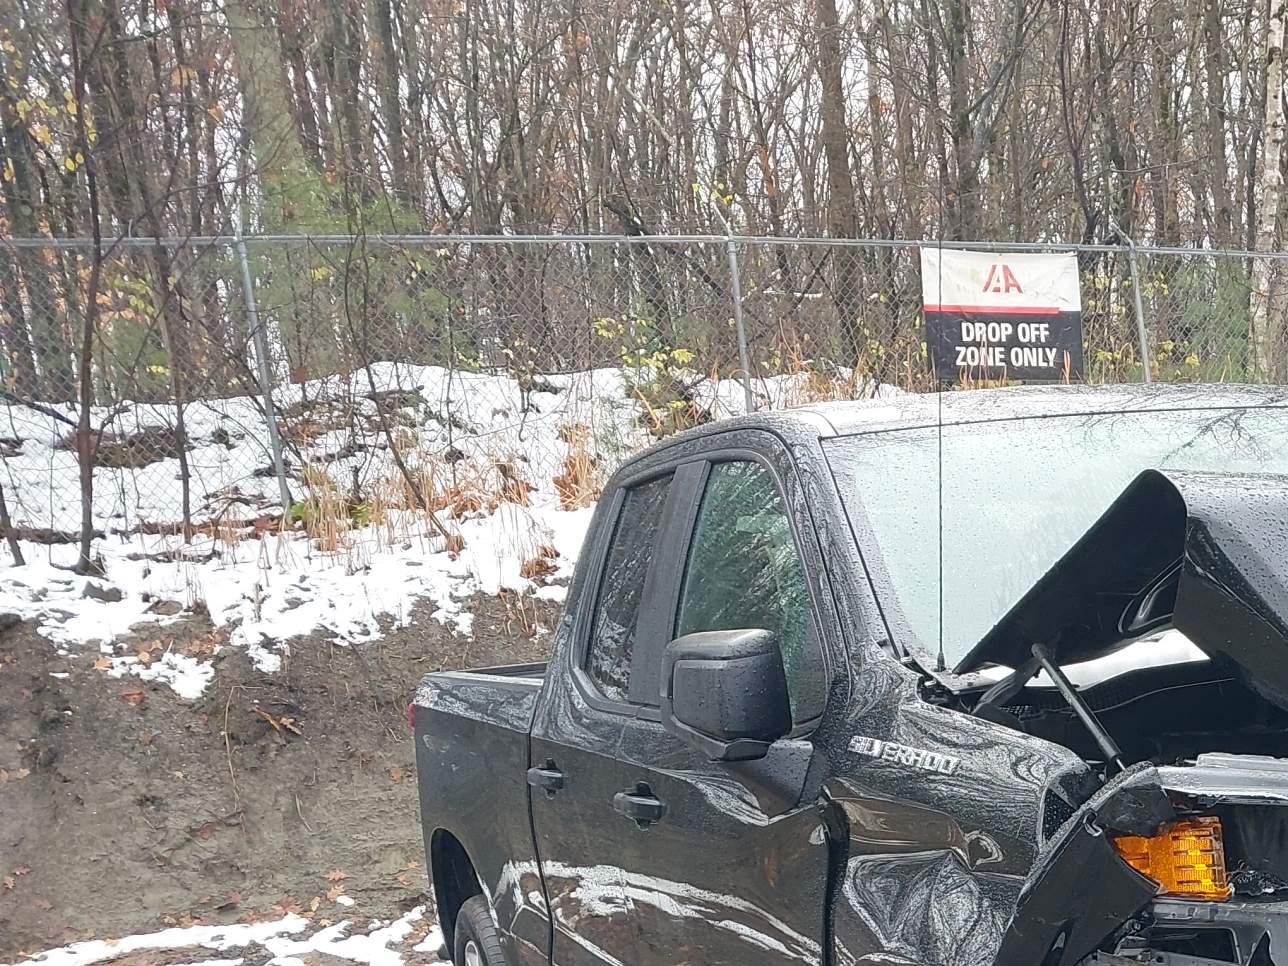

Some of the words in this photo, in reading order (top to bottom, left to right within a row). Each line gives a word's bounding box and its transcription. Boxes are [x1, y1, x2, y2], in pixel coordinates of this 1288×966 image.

[961, 322, 1013, 342] DROP
[1017, 323, 1050, 343] OFF
[955, 347, 1006, 366] ZONE
[1010, 347, 1057, 367] ONLY
